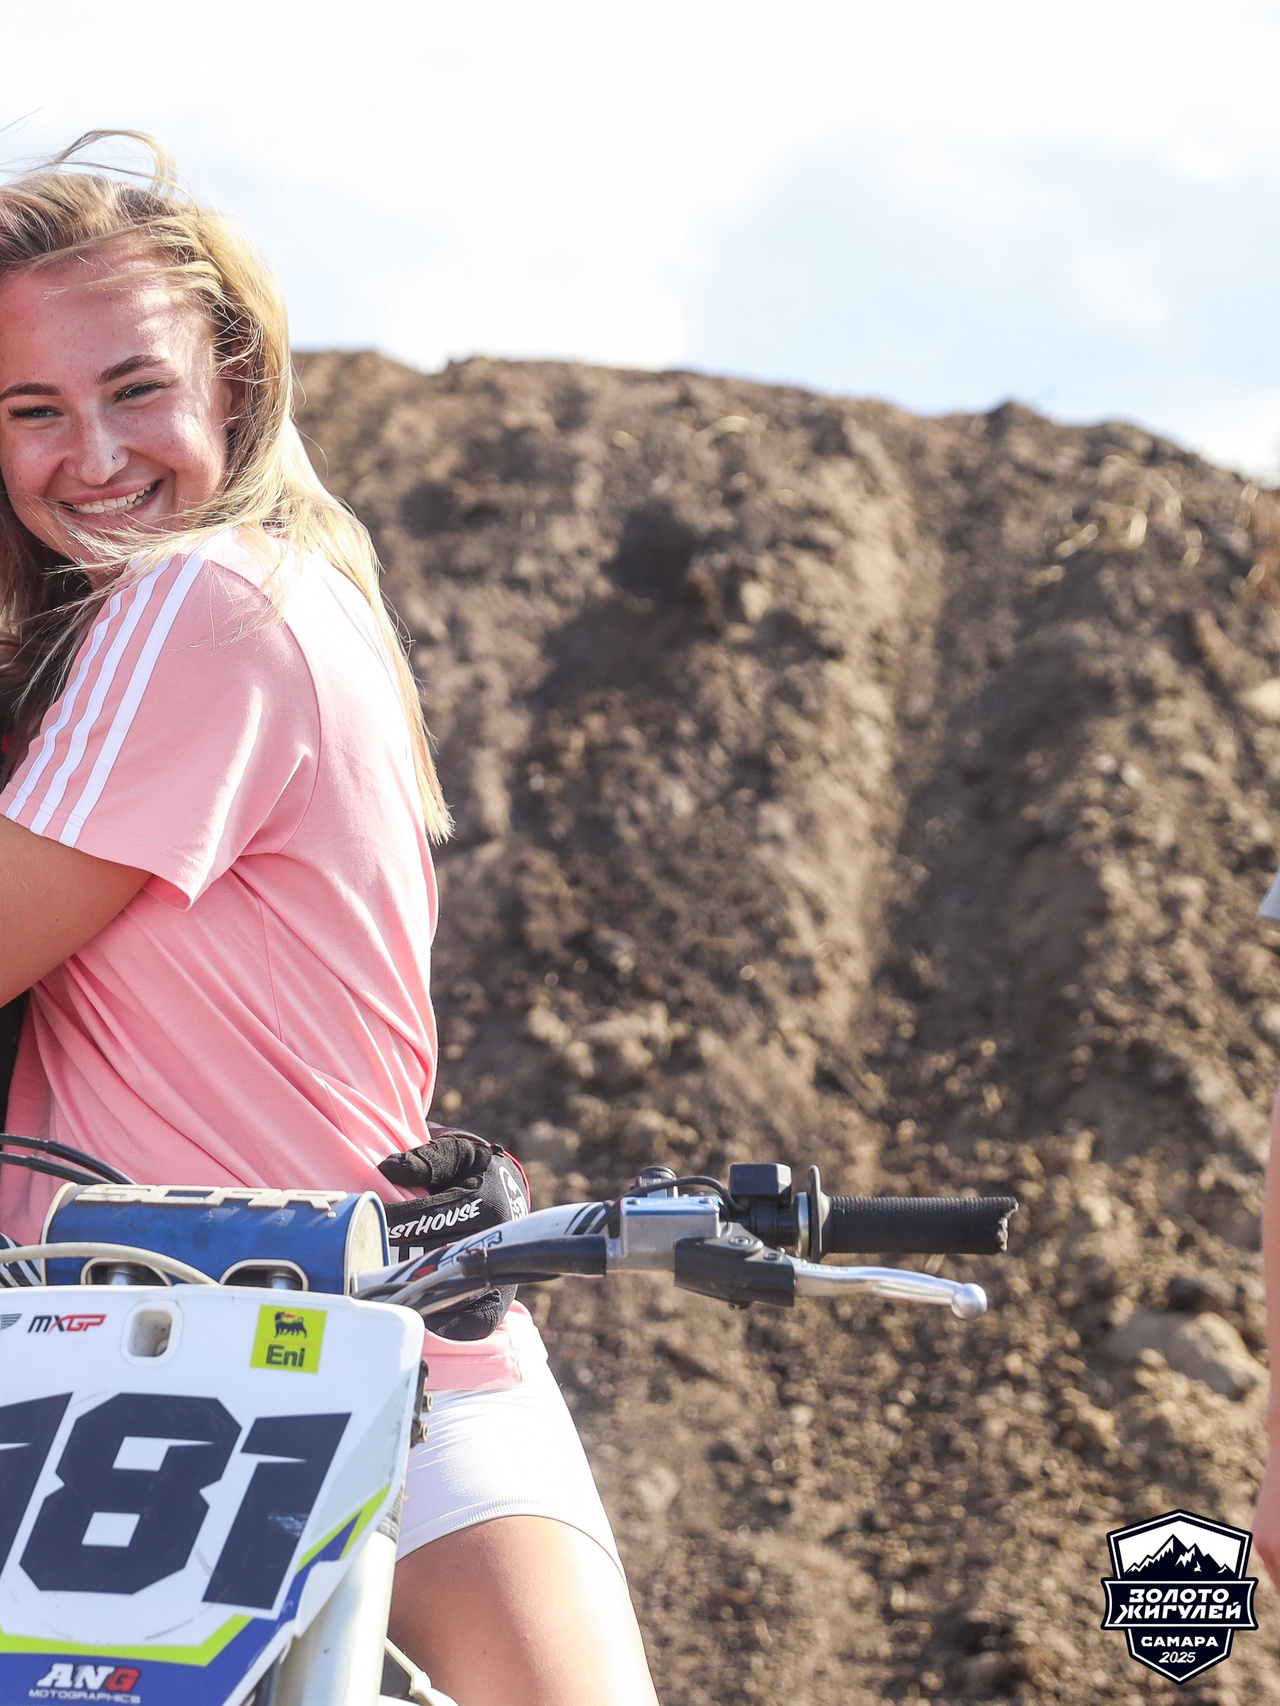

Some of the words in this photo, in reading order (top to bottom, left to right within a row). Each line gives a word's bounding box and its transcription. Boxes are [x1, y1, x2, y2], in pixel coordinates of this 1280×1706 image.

[74, 1184, 348, 1211] SCAR
[387, 1198, 483, 1239] STHOUSE
[28, 1314, 107, 1334] MXGP
[265, 1344, 306, 1368] Eni
[28, 1689, 141, 1704] MOTOGRAPHICS
